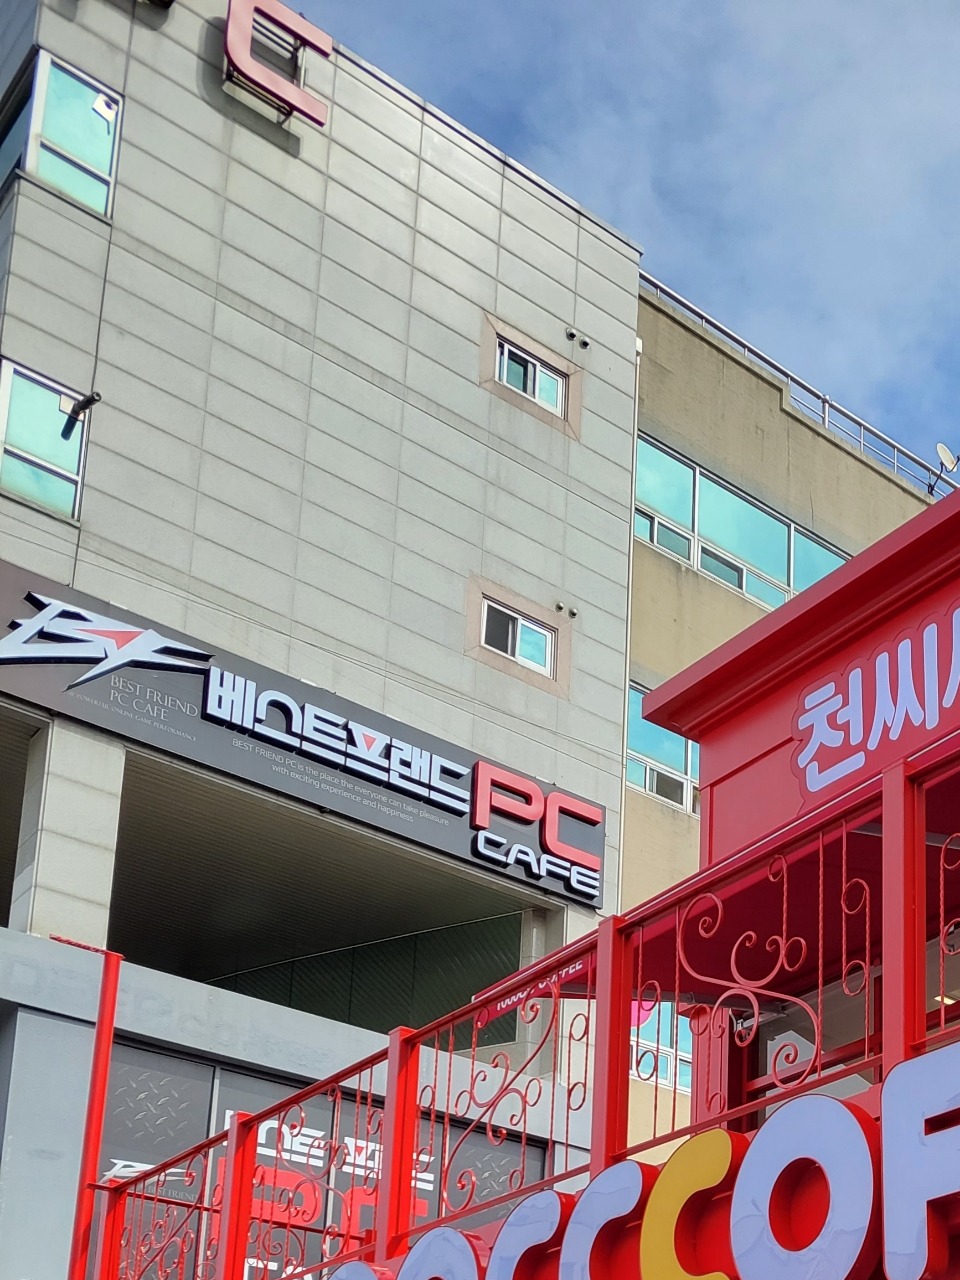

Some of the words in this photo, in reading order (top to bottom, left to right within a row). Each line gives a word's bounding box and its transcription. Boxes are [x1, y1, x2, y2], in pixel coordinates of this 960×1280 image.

[110, 674, 143, 697] BEST
[146, 688, 199, 718] FRIEND
[110, 689, 130, 707] PC
[132, 696, 169, 722] CAFE
[153, 721, 197, 742] PERFORMANCE
[206, 666, 470, 815] 베스트프렌드
[472, 759, 603, 872] PC
[232, 738, 254, 754] BEST
[255, 745, 284, 764] FRIEND
[285, 757, 297, 769] PC
[298, 760, 304, 772] is
[305, 763, 319, 778] the
[319, 768, 341, 786] place
[341, 776, 353, 790] the
[354, 784, 388, 804] everyone
[388, 796, 402, 809] can
[402, 800, 419, 815] take
[419, 808, 450, 827] pleasure
[271, 763, 289, 777] with
[290, 768, 320, 790] exciting
[321, 781, 361, 804] experience
[362, 794, 376, 808] and
[377, 799, 414, 823] happiness
[476, 828, 600, 898] CAFE
